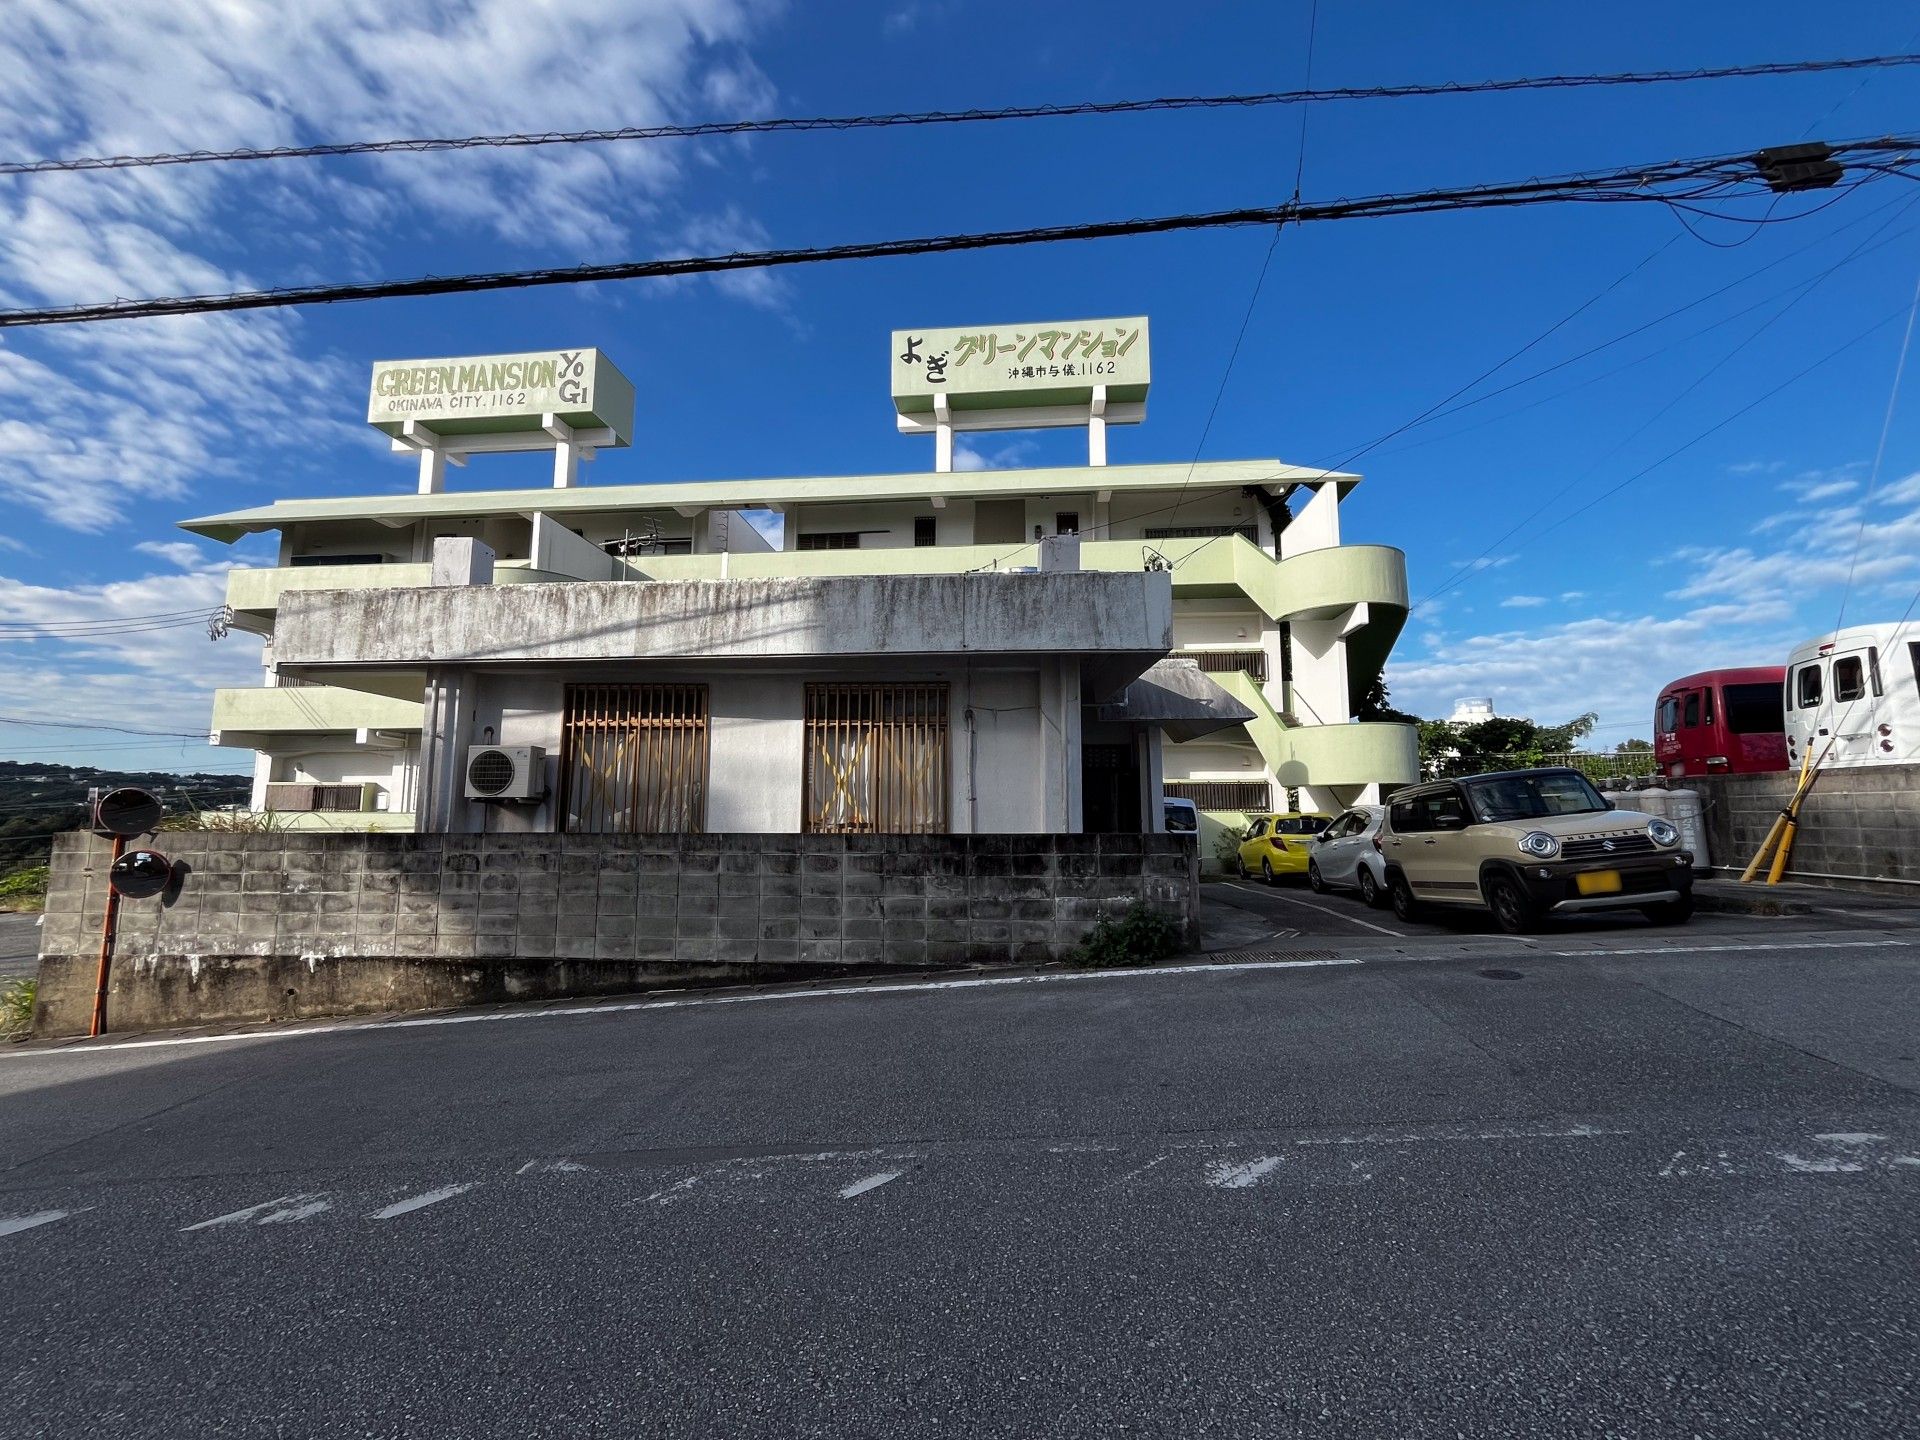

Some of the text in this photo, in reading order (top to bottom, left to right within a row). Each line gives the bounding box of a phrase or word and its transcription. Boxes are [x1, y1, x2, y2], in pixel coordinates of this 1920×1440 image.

[900, 328, 1139, 384] よぎ グリーンマンション
[458, 360, 557, 393] MANSION
[388, 397, 442, 412] OKINAWA
